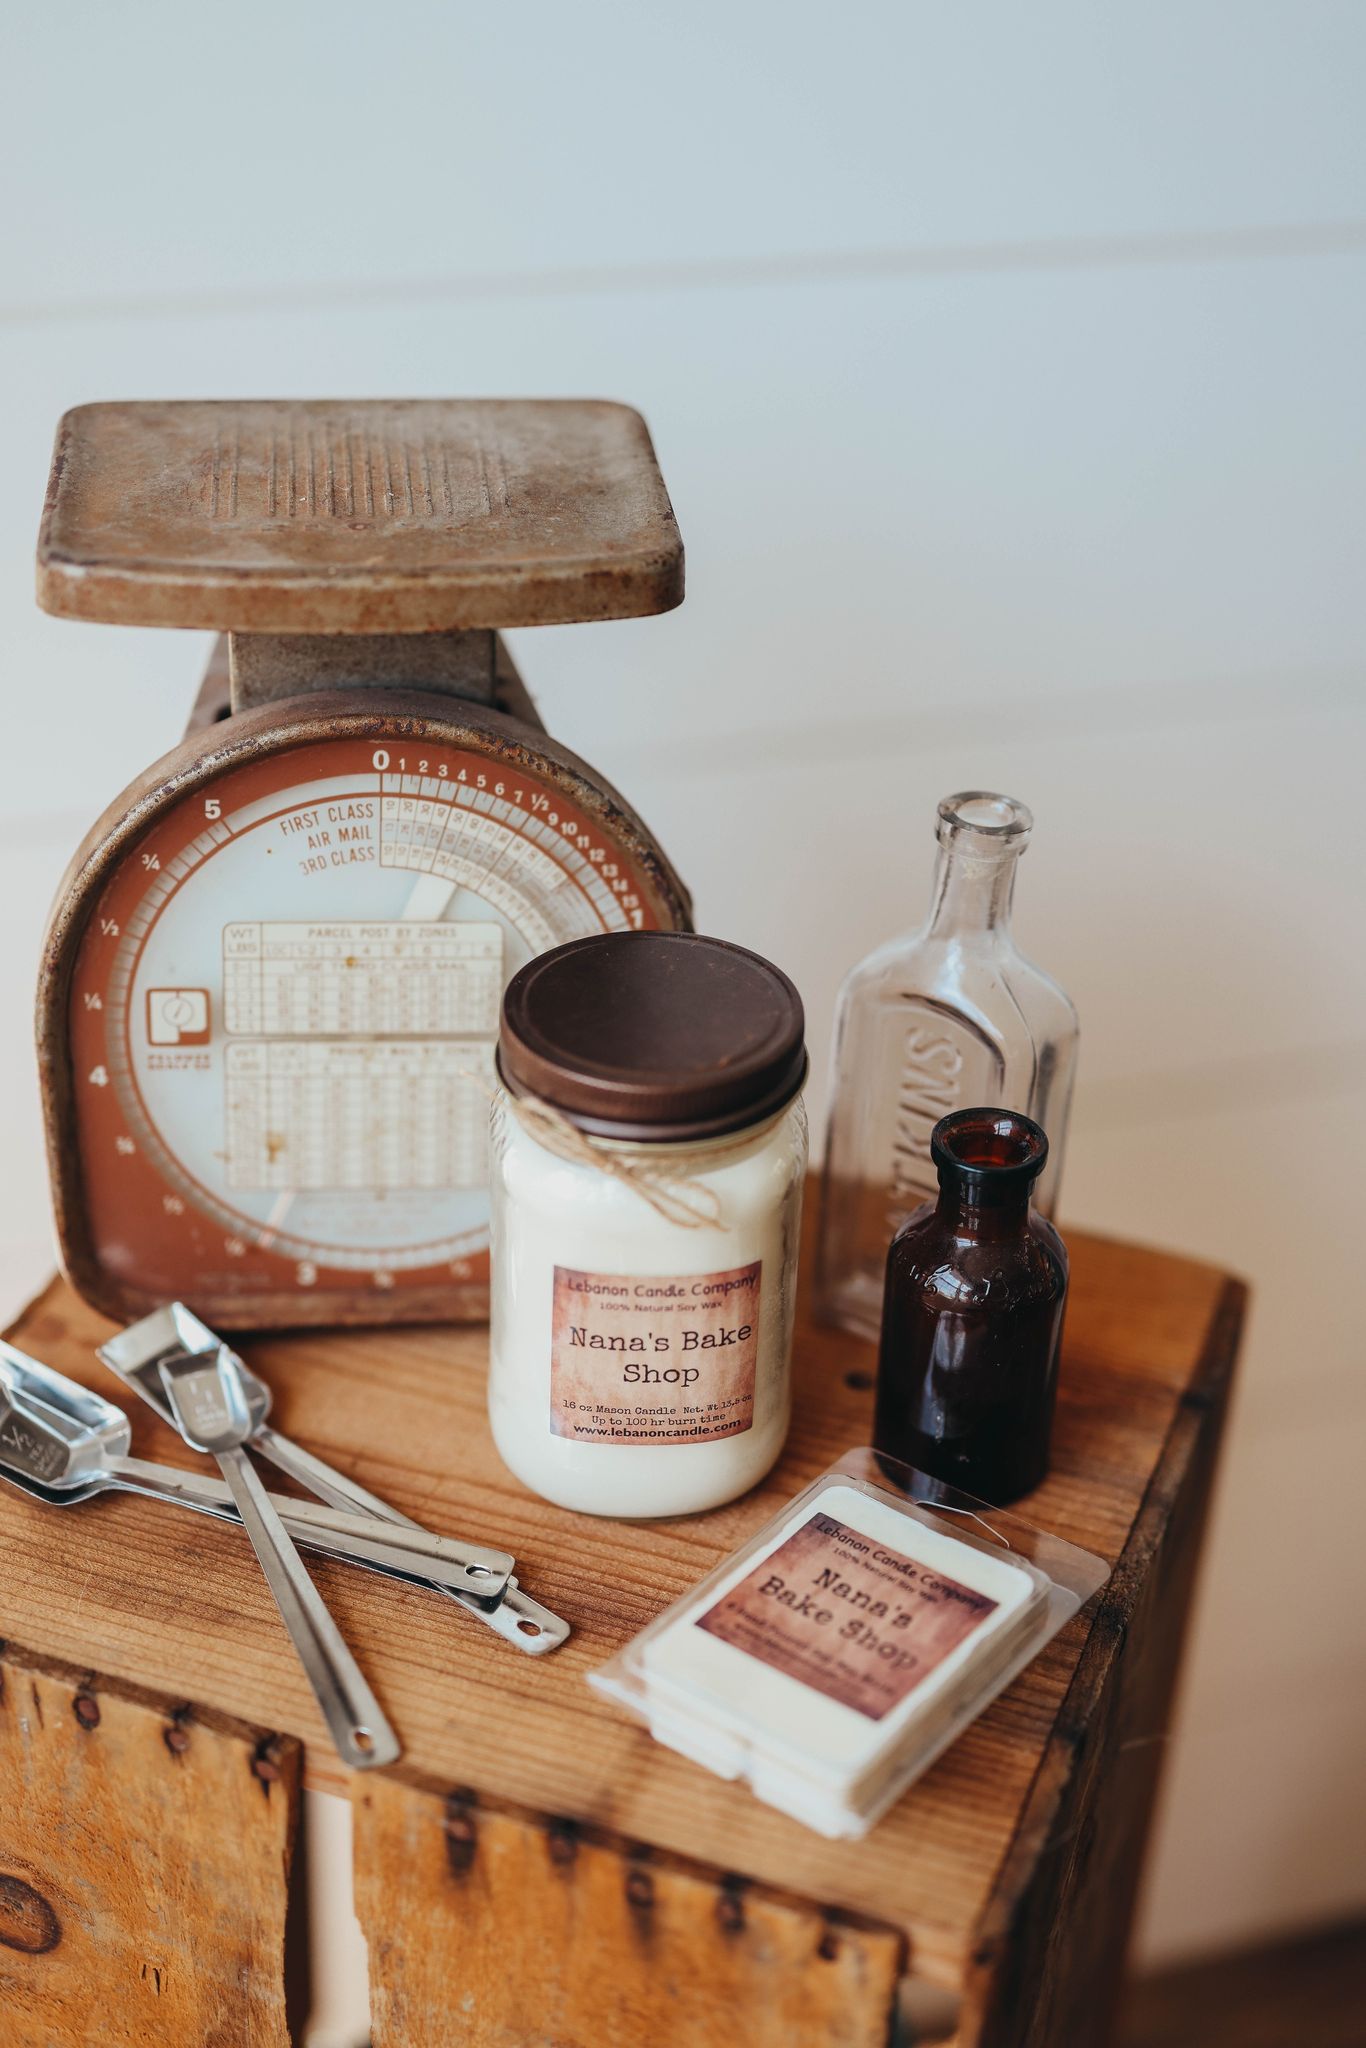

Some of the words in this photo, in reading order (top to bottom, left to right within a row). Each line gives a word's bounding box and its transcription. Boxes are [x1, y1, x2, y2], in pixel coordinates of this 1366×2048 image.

[204, 799, 222, 820] 5
[279, 810, 320, 836] FIRST
[327, 803, 374, 823] CLASS
[307, 831, 332, 849] AIR
[338, 825, 373, 842] MAIL
[372, 750, 390, 770] 0
[399, 758, 406, 770] 1
[419, 760, 428, 773] 2
[438, 764, 448, 777] 3
[457, 769, 467, 781] 4
[477, 775, 487, 788] 5
[495, 782, 505, 795] 6
[514, 790, 523, 804] 7
[548, 812, 559, 826] 9
[560, 822, 578, 835] 10
[576, 836, 590, 849] 11
[589, 849, 605, 862] 12
[601, 864, 618, 877] 13
[631, 908, 644, 929] 1
[299, 855, 327, 876] 3RD
[331, 846, 375, 866] CLASS
[230, 928, 255, 939] WT
[307, 927, 352, 939] PARCEL
[360, 927, 389, 939] POST
[419, 927, 457, 939] ZONES
[88, 1064, 109, 1087] 4
[567, 1277, 629, 1297] Lebanon
[633, 1284, 686, 1298] Candle
[691, 1273, 757, 1297] Company
[600, 1302, 630, 1311] 100%
[634, 1303, 673, 1312] Natural
[677, 1303, 697, 1312] Soy
[701, 1301, 722, 1310] Wax
[569, 1326, 670, 1352] Nana's
[682, 1324, 752, 1350] Bake
[623, 1363, 700, 1388] Shop
[562, 1399, 576, 1409] 16
[579, 1404, 593, 1412] oz
[596, 1405, 631, 1415] Mason
[634, 1406, 677, 1415] Candle
[683, 1406, 704, 1414] Net.
[573, 1419, 742, 1438] www.lebanoncandle.com
[591, 1415, 606, 1426] Up
[609, 1417, 623, 1426] to
[625, 1417, 648, 1426] 100
[650, 1418, 665, 1426] hr
[668, 1417, 697, 1426] burn
[700, 1413, 726, 1424] time
[816, 1521, 870, 1555] Lebanon
[872, 1550, 917, 1577] Candle
[812, 1567, 913, 1629] Nana's
[757, 1575, 833, 1627] Bake
[838, 1618, 918, 1671] Shop
